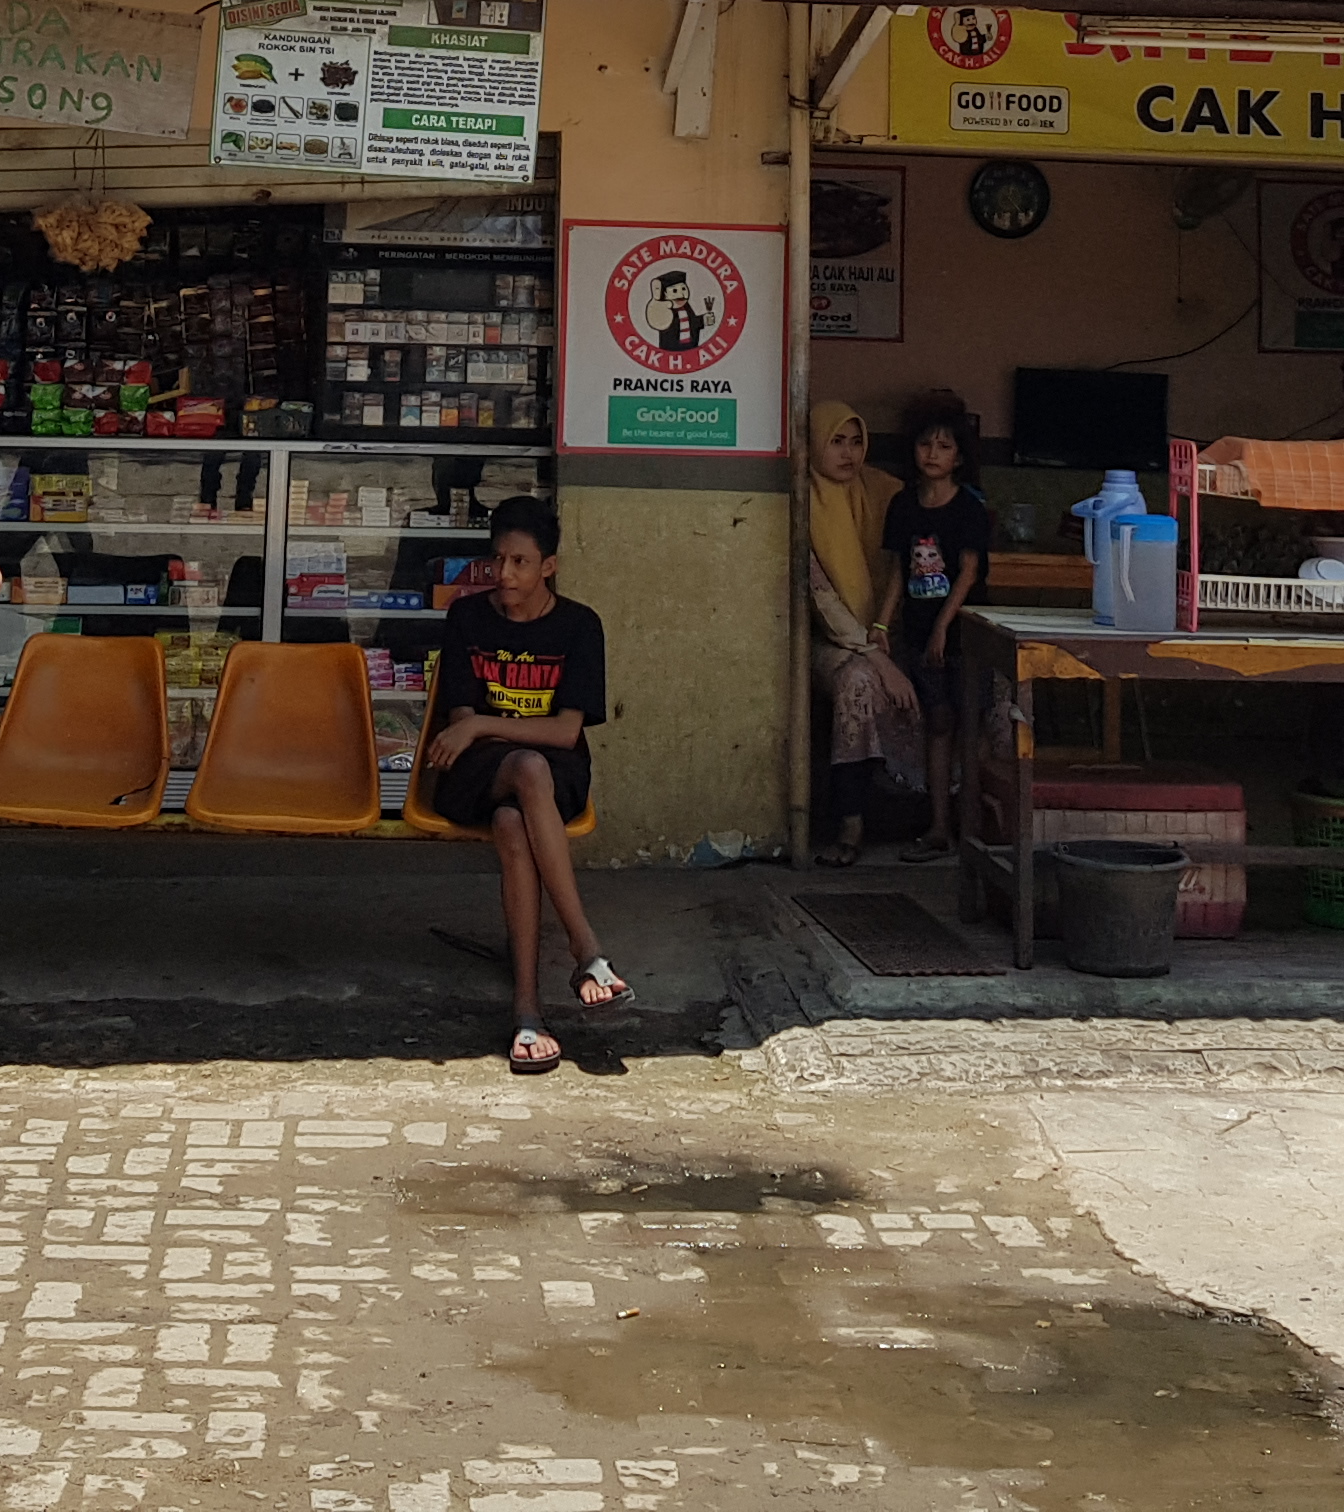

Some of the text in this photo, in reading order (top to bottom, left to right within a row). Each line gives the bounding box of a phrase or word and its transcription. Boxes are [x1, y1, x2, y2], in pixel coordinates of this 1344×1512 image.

[227, 6, 265, 25] DISINI
[258, 42, 297, 53] ROKOK
[263, 32, 331, 45] KANDUNGAN
[430, 32, 489, 48] KHASIAT
[1006, 93, 1062, 113] FOOD
[1135, 84, 1283, 139] CAK
[411, 113, 497, 131] CARA TERAPI
[613, 239, 741, 294] SATE MADURA
[623, 334, 729, 371] CAK H. ALI
[612, 377, 733, 394] PRANCIS RAYA
[636, 405, 720, 424] GrabFood
[496, 649, 513, 661] We
